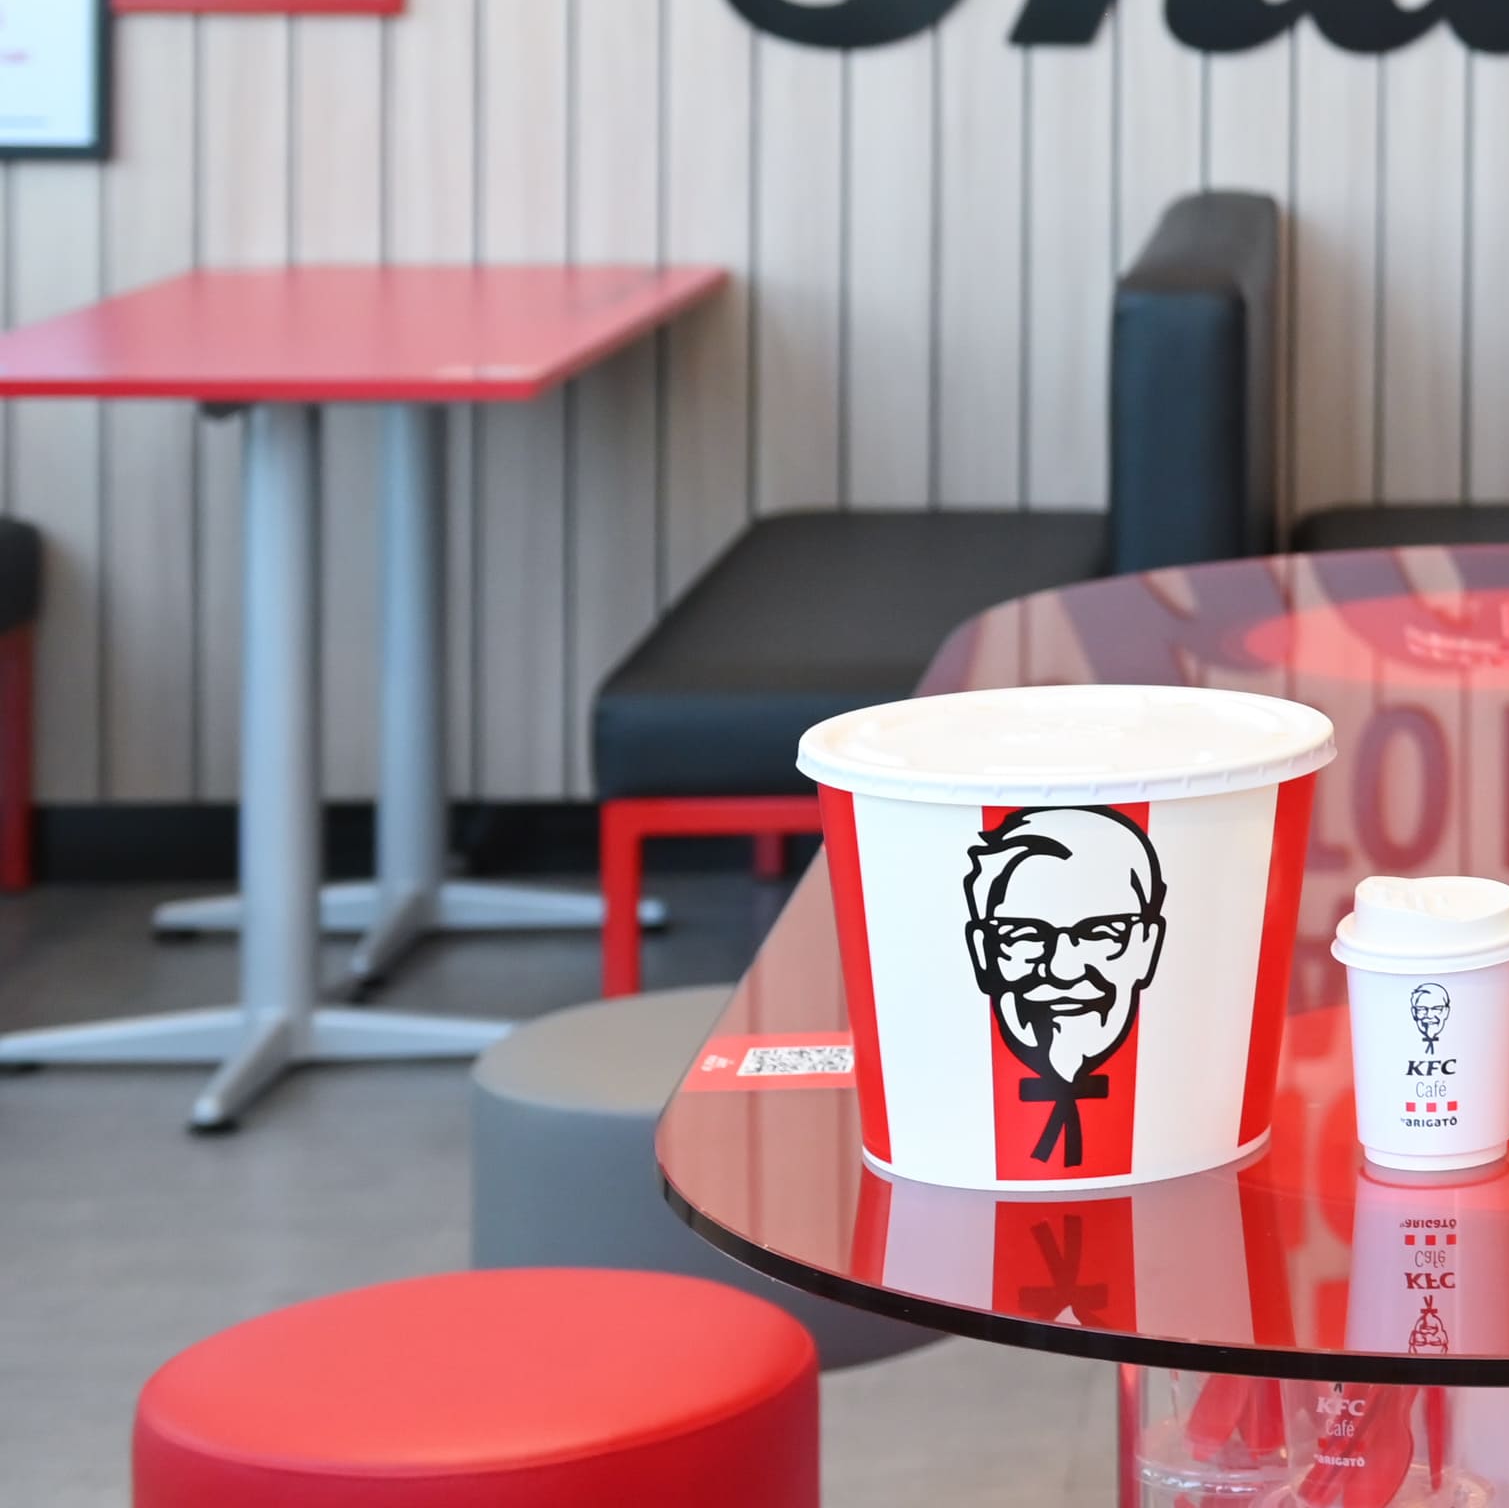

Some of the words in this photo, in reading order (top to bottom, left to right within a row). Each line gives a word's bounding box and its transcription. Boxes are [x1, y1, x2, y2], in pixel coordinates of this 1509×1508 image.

[1406, 1058, 1457, 1076] KFC
[1416, 1080, 1447, 1098] Café
[1316, 1396, 1366, 1416] KFC
